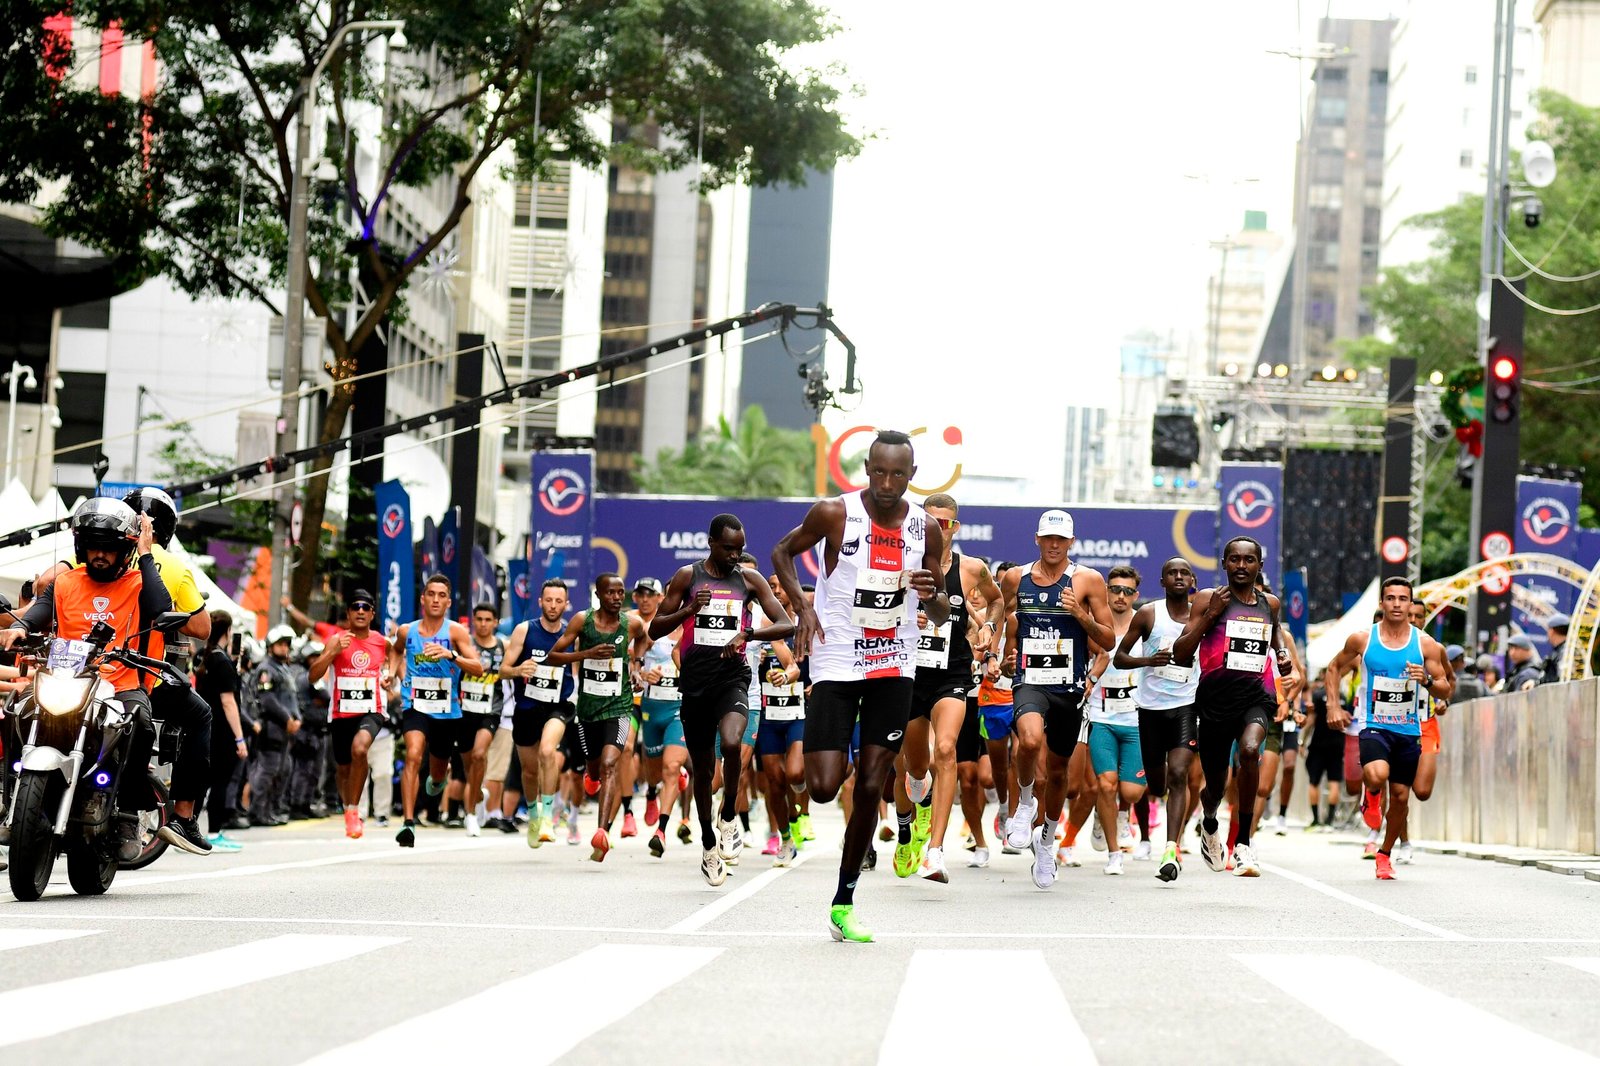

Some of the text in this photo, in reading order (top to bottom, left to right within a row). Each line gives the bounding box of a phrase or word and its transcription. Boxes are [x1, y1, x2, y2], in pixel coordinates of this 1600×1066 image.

[660, 531, 709, 549] LARG
[865, 533, 906, 550] CIMED
[874, 594, 895, 608] 37
[708, 617, 725, 628] 36
[1029, 626, 1060, 639] Unit
[917, 638, 932, 649] 25
[1244, 641, 1260, 653] 32
[532, 649, 546, 657] ECO
[1043, 656, 1052, 667] 2
[594, 672, 607, 681] 19
[536, 679, 550, 688] 29
[660, 678, 674, 687] 22
[350, 690, 364, 700] 96
[424, 690, 438, 700] 92
[1117, 689, 1126, 698] 6
[1388, 693, 1403, 702] 28
[777, 697, 789, 706] 17
